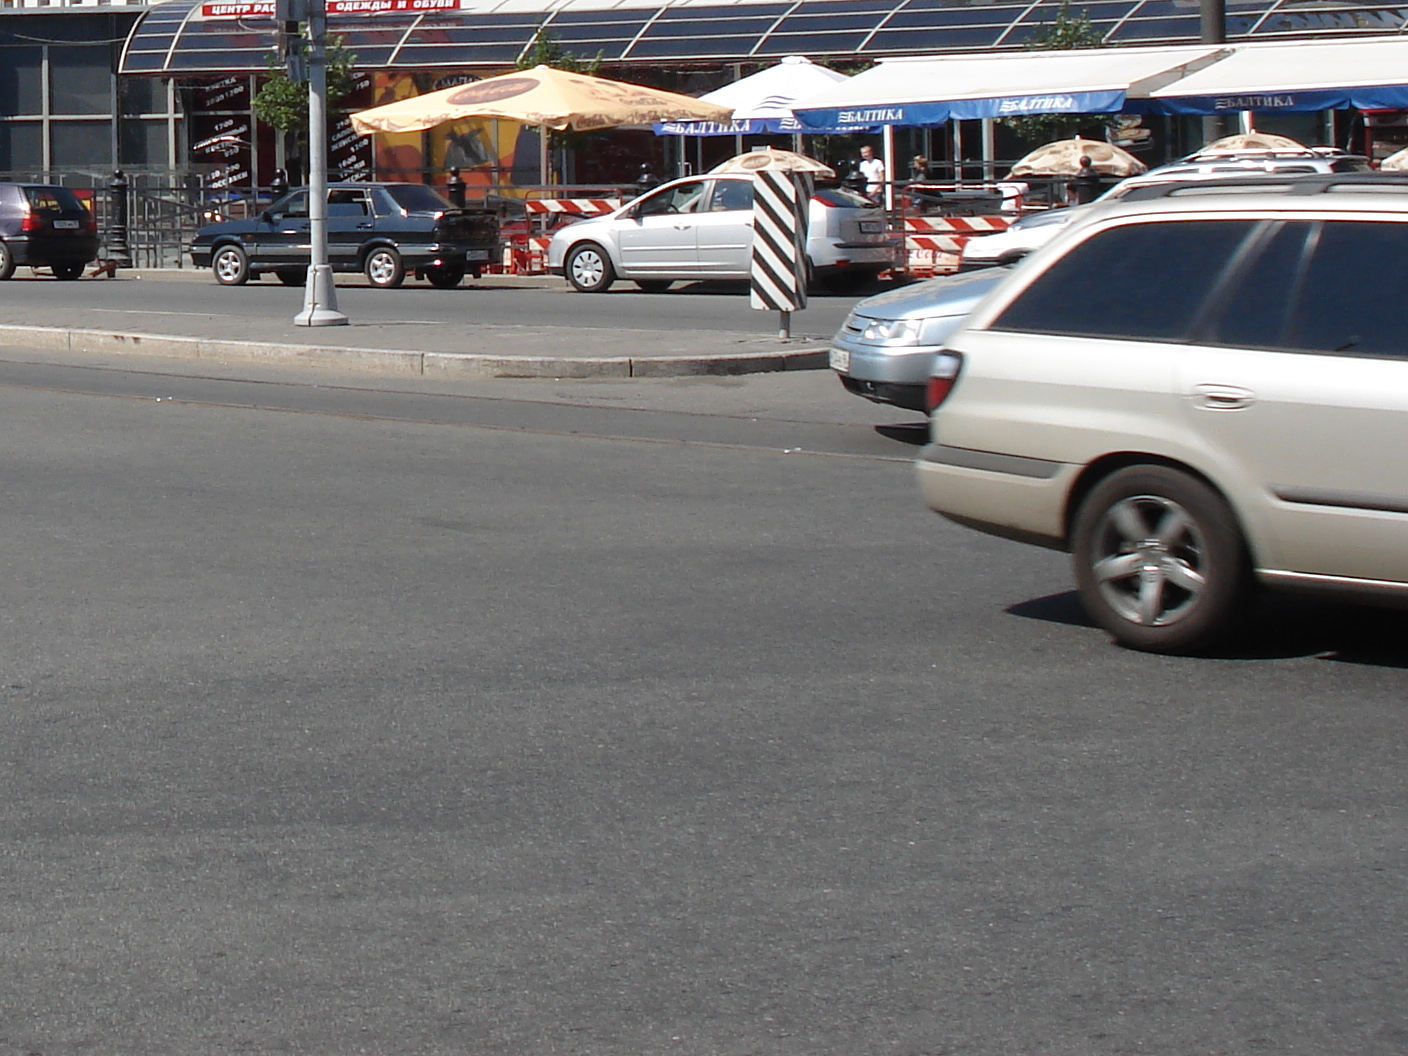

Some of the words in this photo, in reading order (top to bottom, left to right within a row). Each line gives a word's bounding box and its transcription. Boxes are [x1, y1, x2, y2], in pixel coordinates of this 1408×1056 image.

[211, 5, 251, 15] ЦЕНТР
[335, 0, 392, 12] ОДЕЖДЫ
[397, 0, 407, 9] И
[1226, 95, 1294, 109] БАЛТИКА
[845, 108, 904, 122] БАЛТИКА
[675, 119, 750, 134] БАЛТИКА
